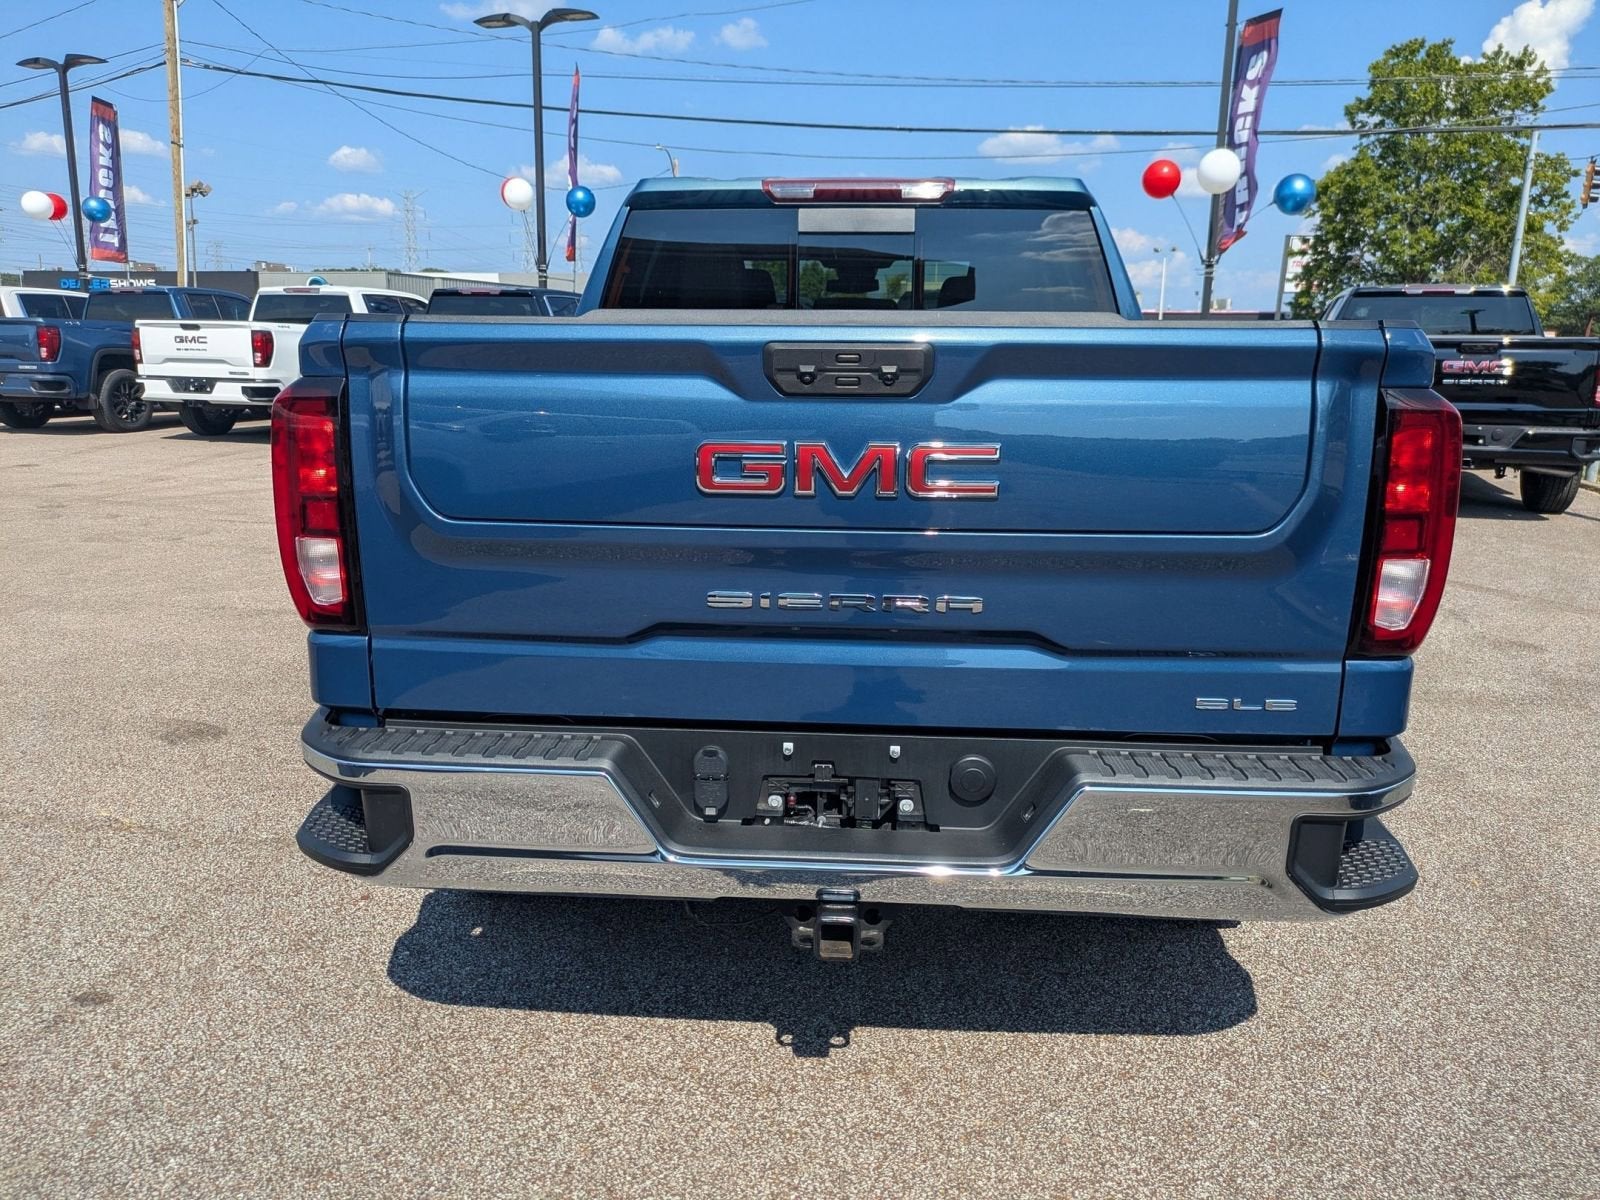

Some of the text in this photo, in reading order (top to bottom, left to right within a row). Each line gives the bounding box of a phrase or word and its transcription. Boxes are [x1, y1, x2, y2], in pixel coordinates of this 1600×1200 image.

[174, 335, 208, 344] GMC
[1442, 359, 1513, 375] GMC
[696, 440, 1001, 499] GMC
[706, 591, 984, 614] SIERRA
[1195, 697, 1298, 711] SLE
